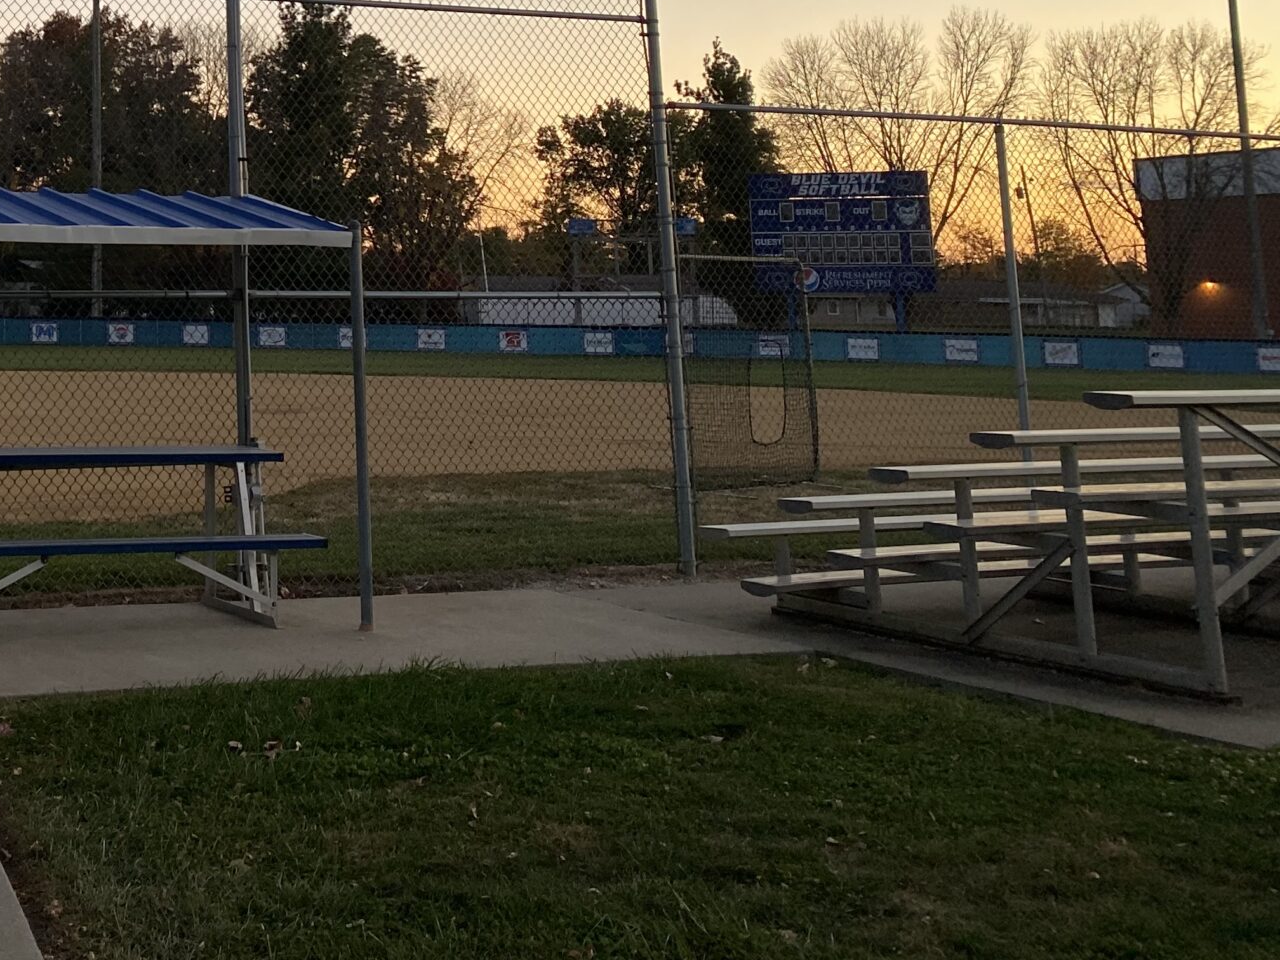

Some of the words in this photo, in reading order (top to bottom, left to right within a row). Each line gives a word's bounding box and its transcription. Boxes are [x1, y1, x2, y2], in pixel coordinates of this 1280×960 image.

[791, 174, 831, 185] BLUE
[838, 173, 886, 184] DEVIL
[798, 185, 879, 196] SOFTBALL
[853, 207, 870, 215] OUT
[755, 238, 782, 246] GUEST
